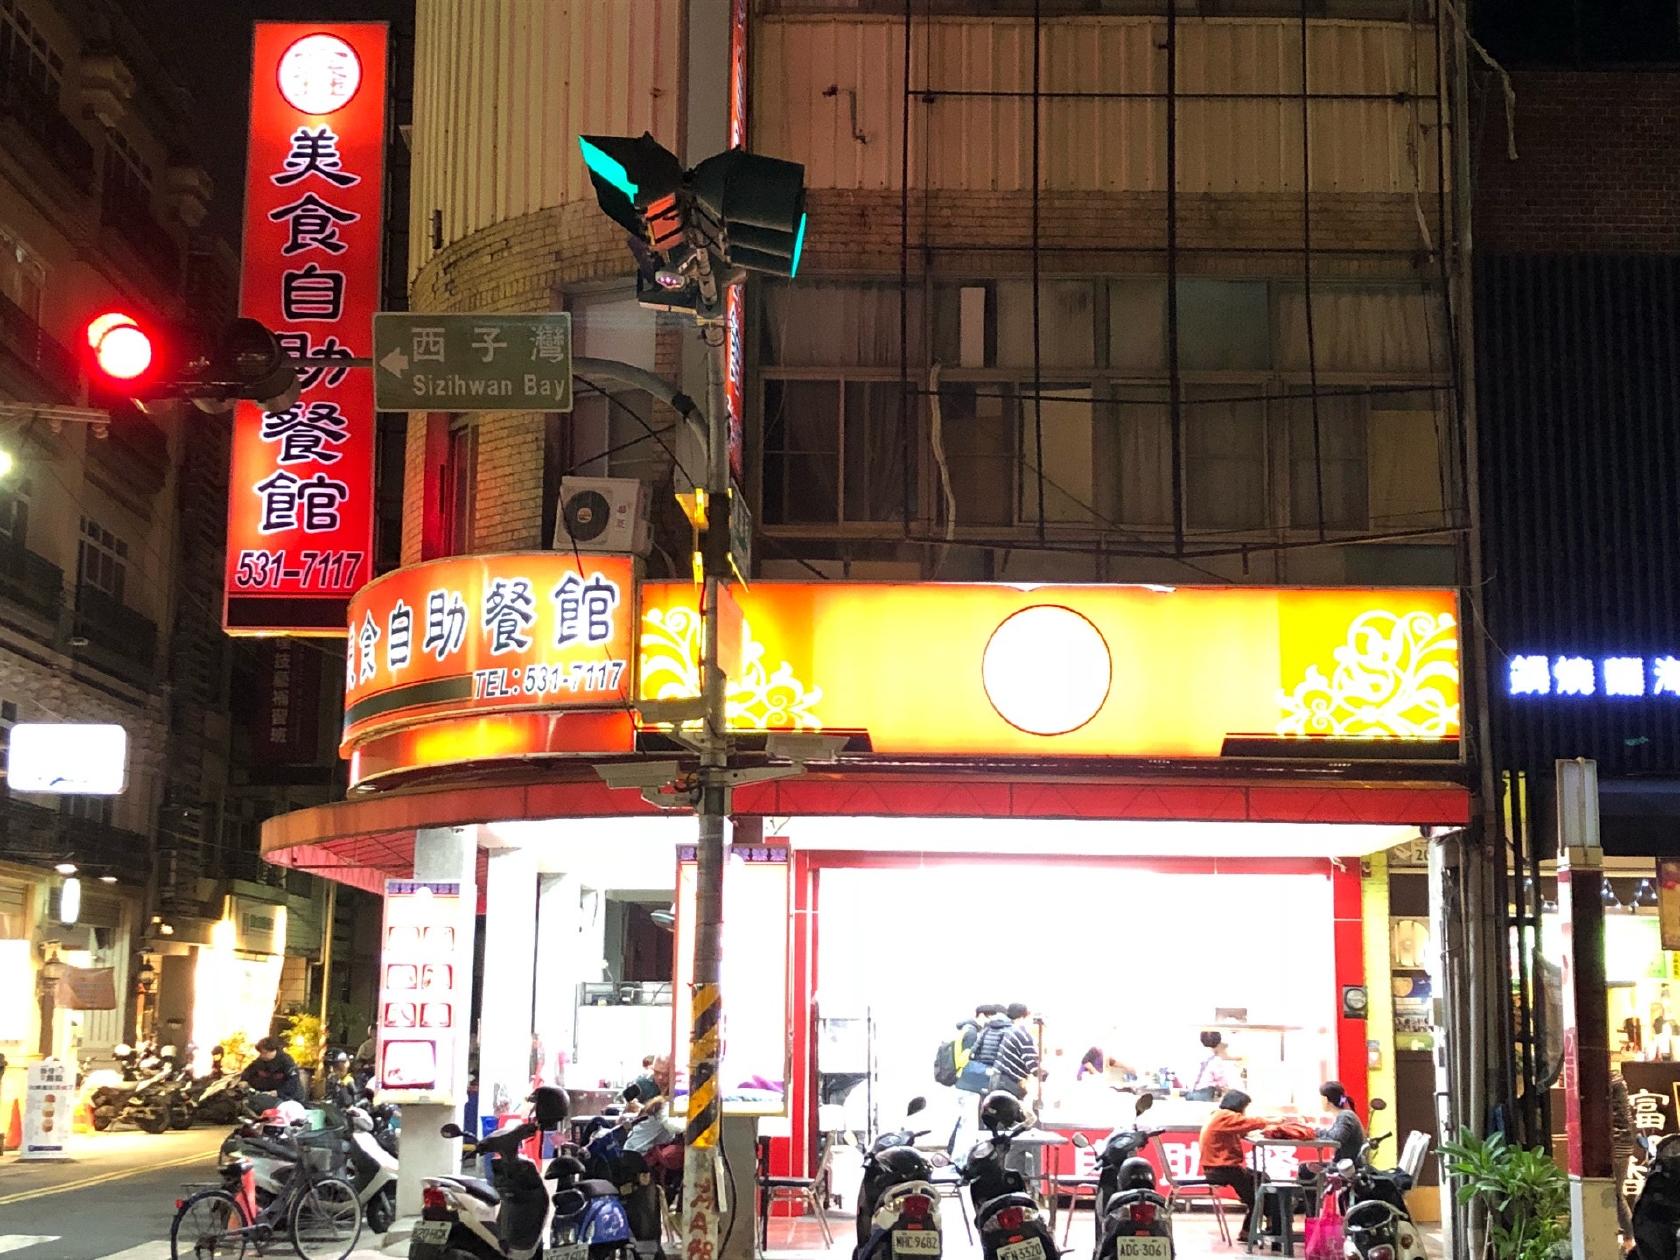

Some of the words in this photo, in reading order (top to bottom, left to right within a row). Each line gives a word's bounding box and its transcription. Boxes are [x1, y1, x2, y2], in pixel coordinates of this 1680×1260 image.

[411, 326, 565, 363] 西子灣
[412, 374, 512, 396] Sizihwan
[523, 374, 565, 400] Bay
[236, 550, 362, 588] 531-7117
